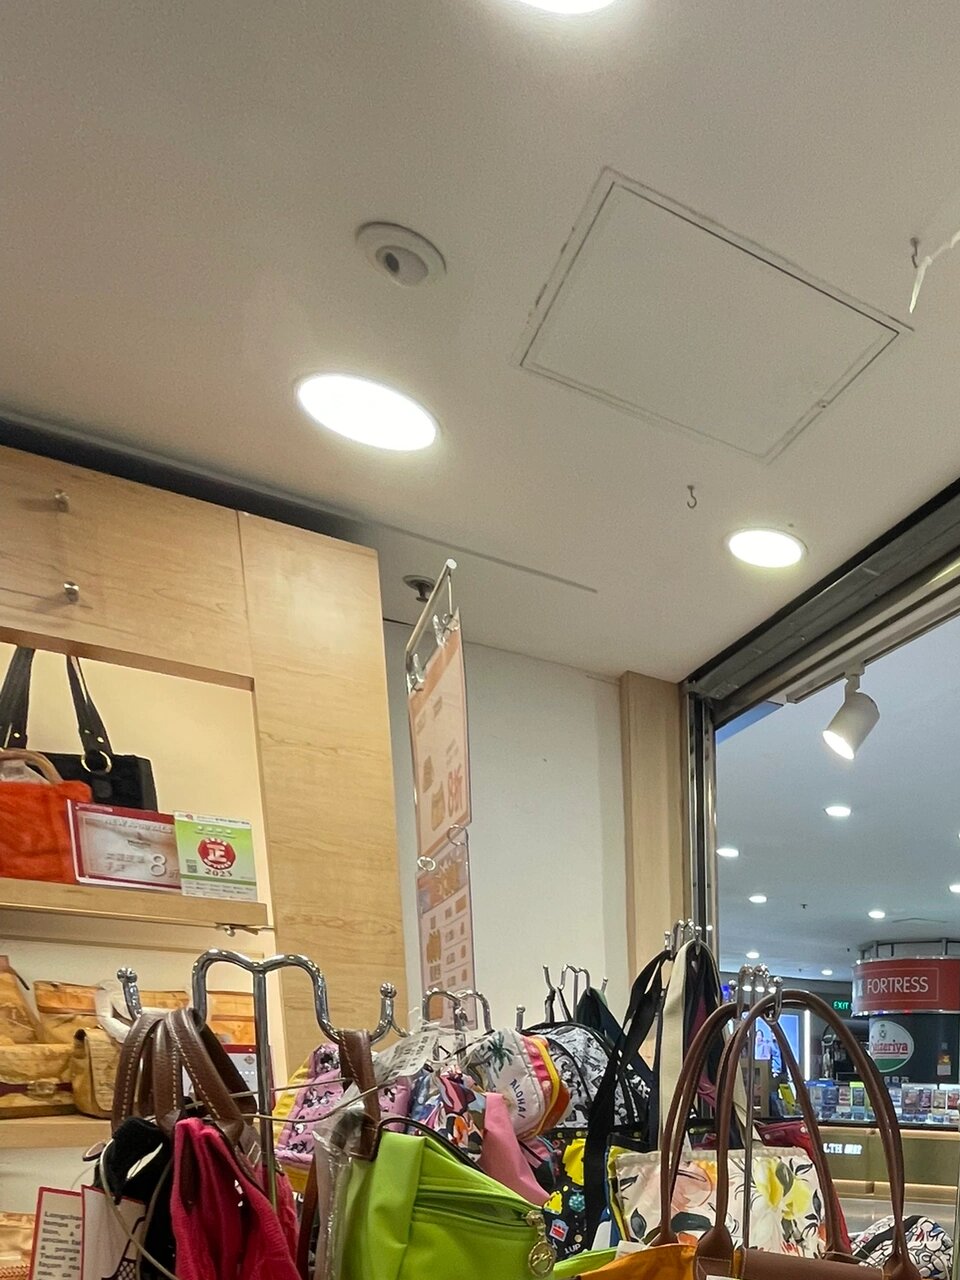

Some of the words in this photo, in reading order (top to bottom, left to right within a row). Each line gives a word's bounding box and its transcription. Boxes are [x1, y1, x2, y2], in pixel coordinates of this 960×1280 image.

[206, 843, 227, 863] 正
[867, 977, 929, 994] FORTRESS
[833, 1001, 849, 1010] EXIT
